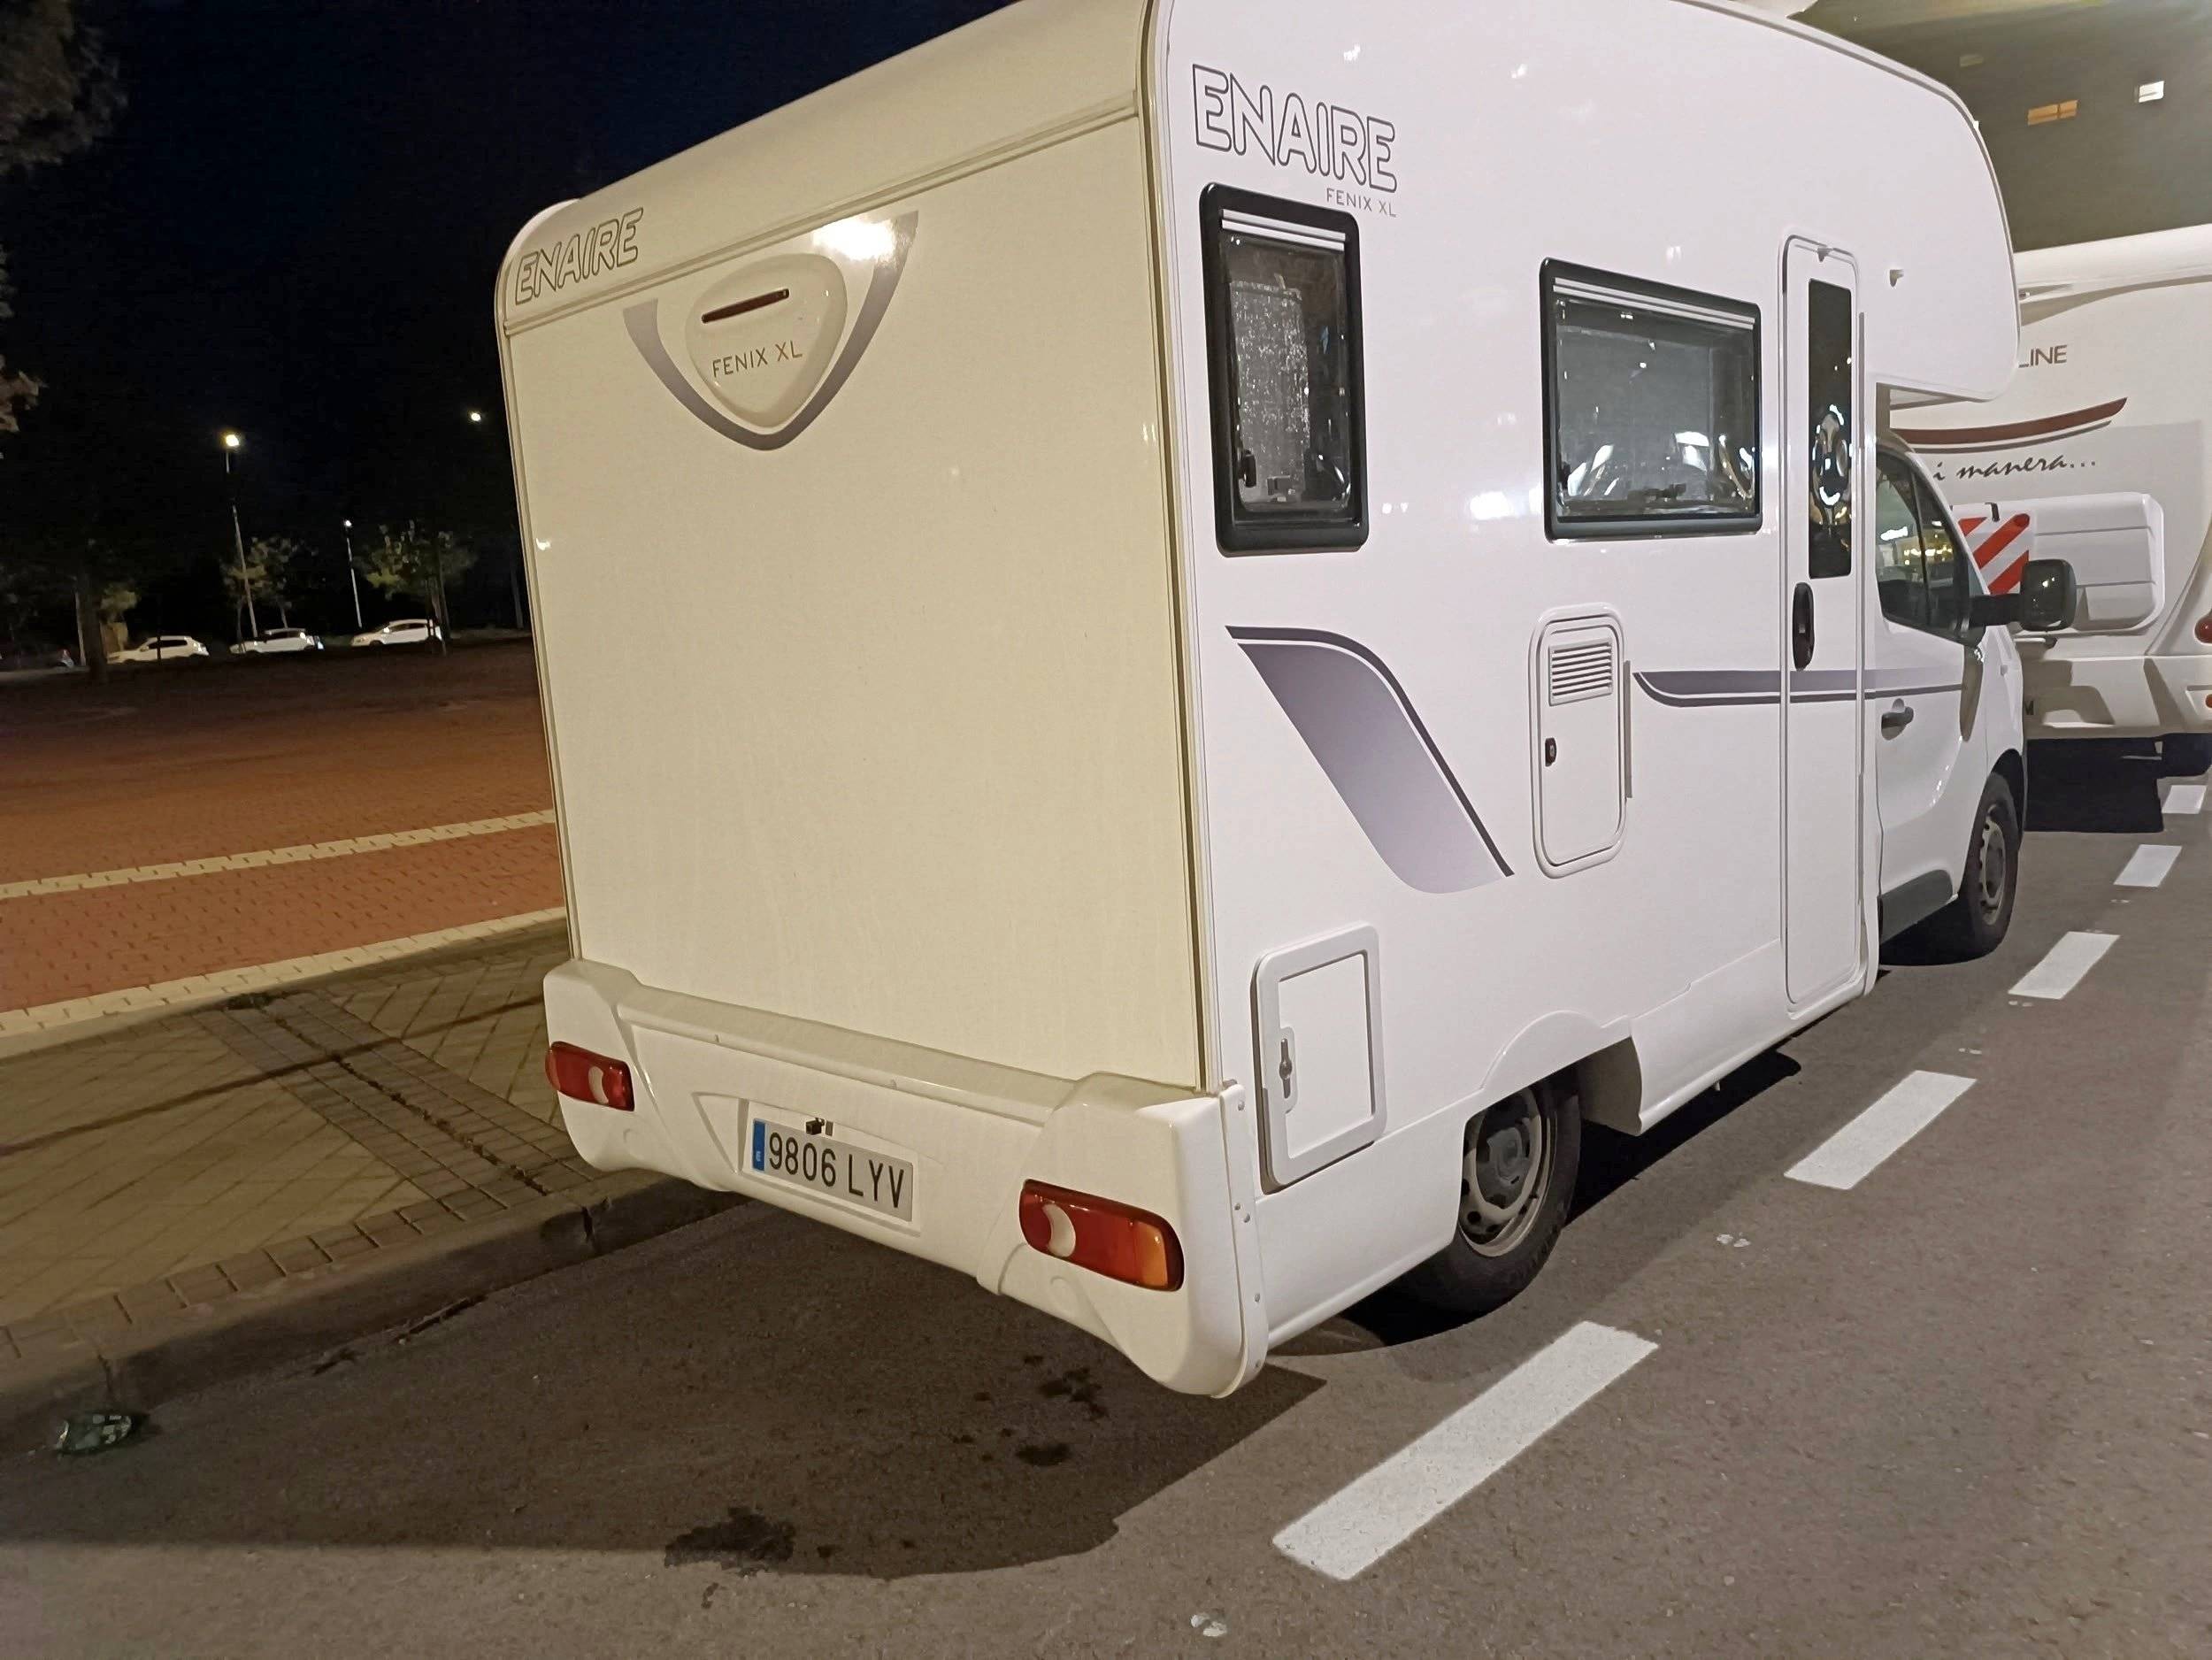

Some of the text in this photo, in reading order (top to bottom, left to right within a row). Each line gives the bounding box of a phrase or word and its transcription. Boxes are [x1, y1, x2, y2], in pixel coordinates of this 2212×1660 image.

[1192, 64, 1397, 193] ENAIRE
[1326, 187, 1396, 218] FENIX XL
[515, 206, 644, 305] ENAIRE
[712, 340, 803, 378] FENIX XL
[2018, 344, 2068, 368] INE
[769, 1132, 904, 1209] 9806 LYV
